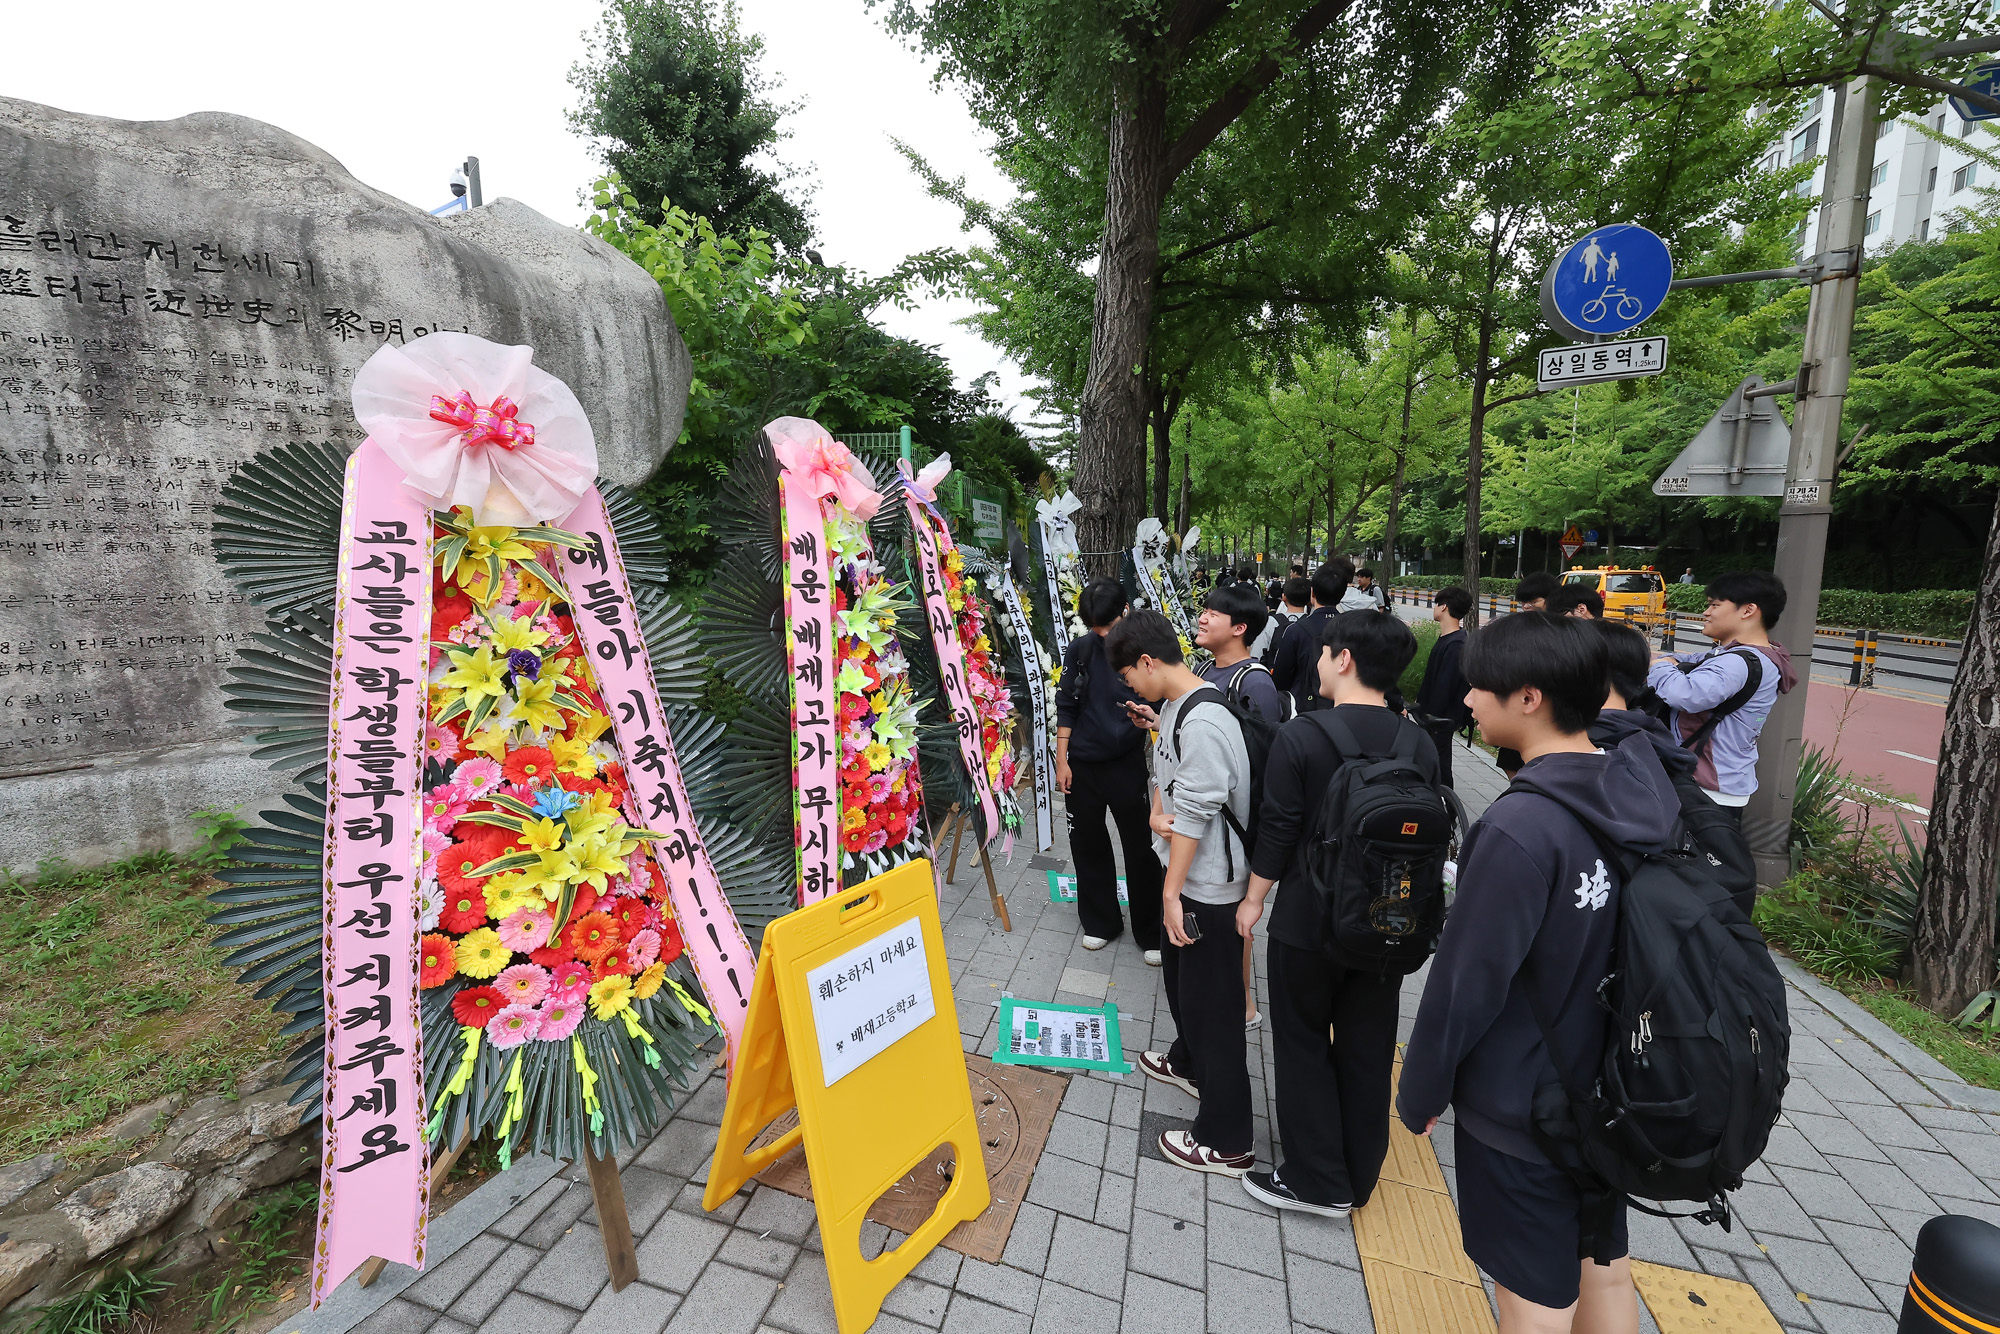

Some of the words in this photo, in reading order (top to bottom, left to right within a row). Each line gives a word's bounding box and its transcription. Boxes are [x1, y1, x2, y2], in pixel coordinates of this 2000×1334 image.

[142, 240, 180, 269] 저
[324, 307, 468, 345] 黎明이
[1547, 346, 1632, 376] 상일동역
[1635, 360, 1658, 368] 1.25km
[209, 350, 268, 369] 설립한
[301, 363, 336, 377] 나라
[349, 520, 420, 654] 교사들은
[791, 531, 827, 605] 배운
[128, 635, 205, 648] 이전하여
[916, 523, 953, 646] 변호사
[945, 663, 985, 792] 이하상
[1004, 589, 1036, 664] 민주주의는
[793, 616, 833, 771] 배재고가
[341, 666, 414, 848] 학생들부터
[617, 689, 749, 1009] 기죽지마!!!
[1574, 858, 1612, 912] 培
[337, 863, 404, 939] 우선
[818, 957, 875, 1001] 훼손하지
[880, 936, 917, 964] 마세요
[850, 994, 918, 1043] 배재고등학교
[336, 954, 411, 1174] 지켜주세요
